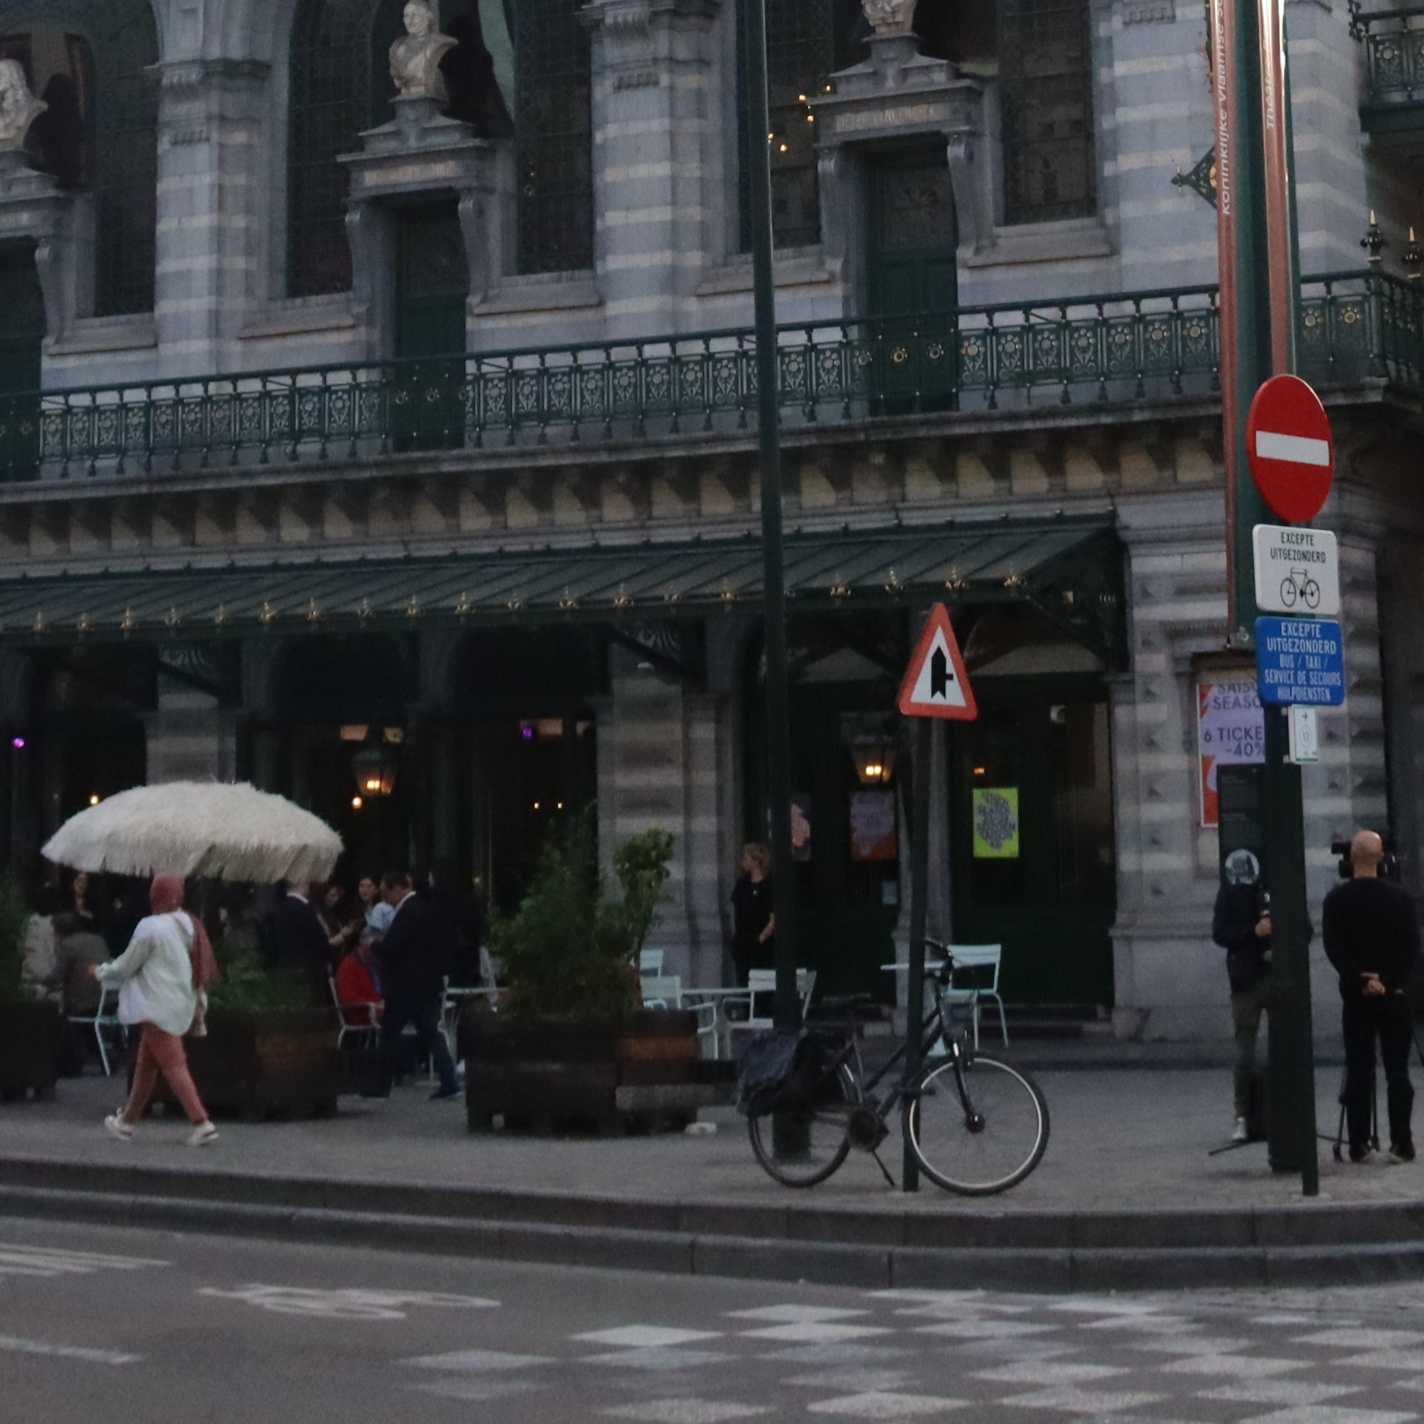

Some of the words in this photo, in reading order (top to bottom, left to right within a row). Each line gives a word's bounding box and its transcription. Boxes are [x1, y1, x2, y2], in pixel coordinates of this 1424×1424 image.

[1218, 109, 1231, 215] Koninklijke
[1280, 532, 1315, 546] EXCEPTE
[1270, 548, 1326, 563] UITGEZONDERD
[1281, 622, 1321, 638] EXCEPTE
[1267, 637, 1337, 655] UITGEZONDERD
[1279, 654, 1295, 669] BUS
[1305, 655, 1321, 669] TAXI
[1265, 669, 1296, 685] SERVICE
[1297, 670, 1308, 684] DE
[1309, 670, 1342, 686] SECOURS
[1277, 686, 1331, 702] HULPDIENSTEN
[1204, 726, 1212, 743] 6
